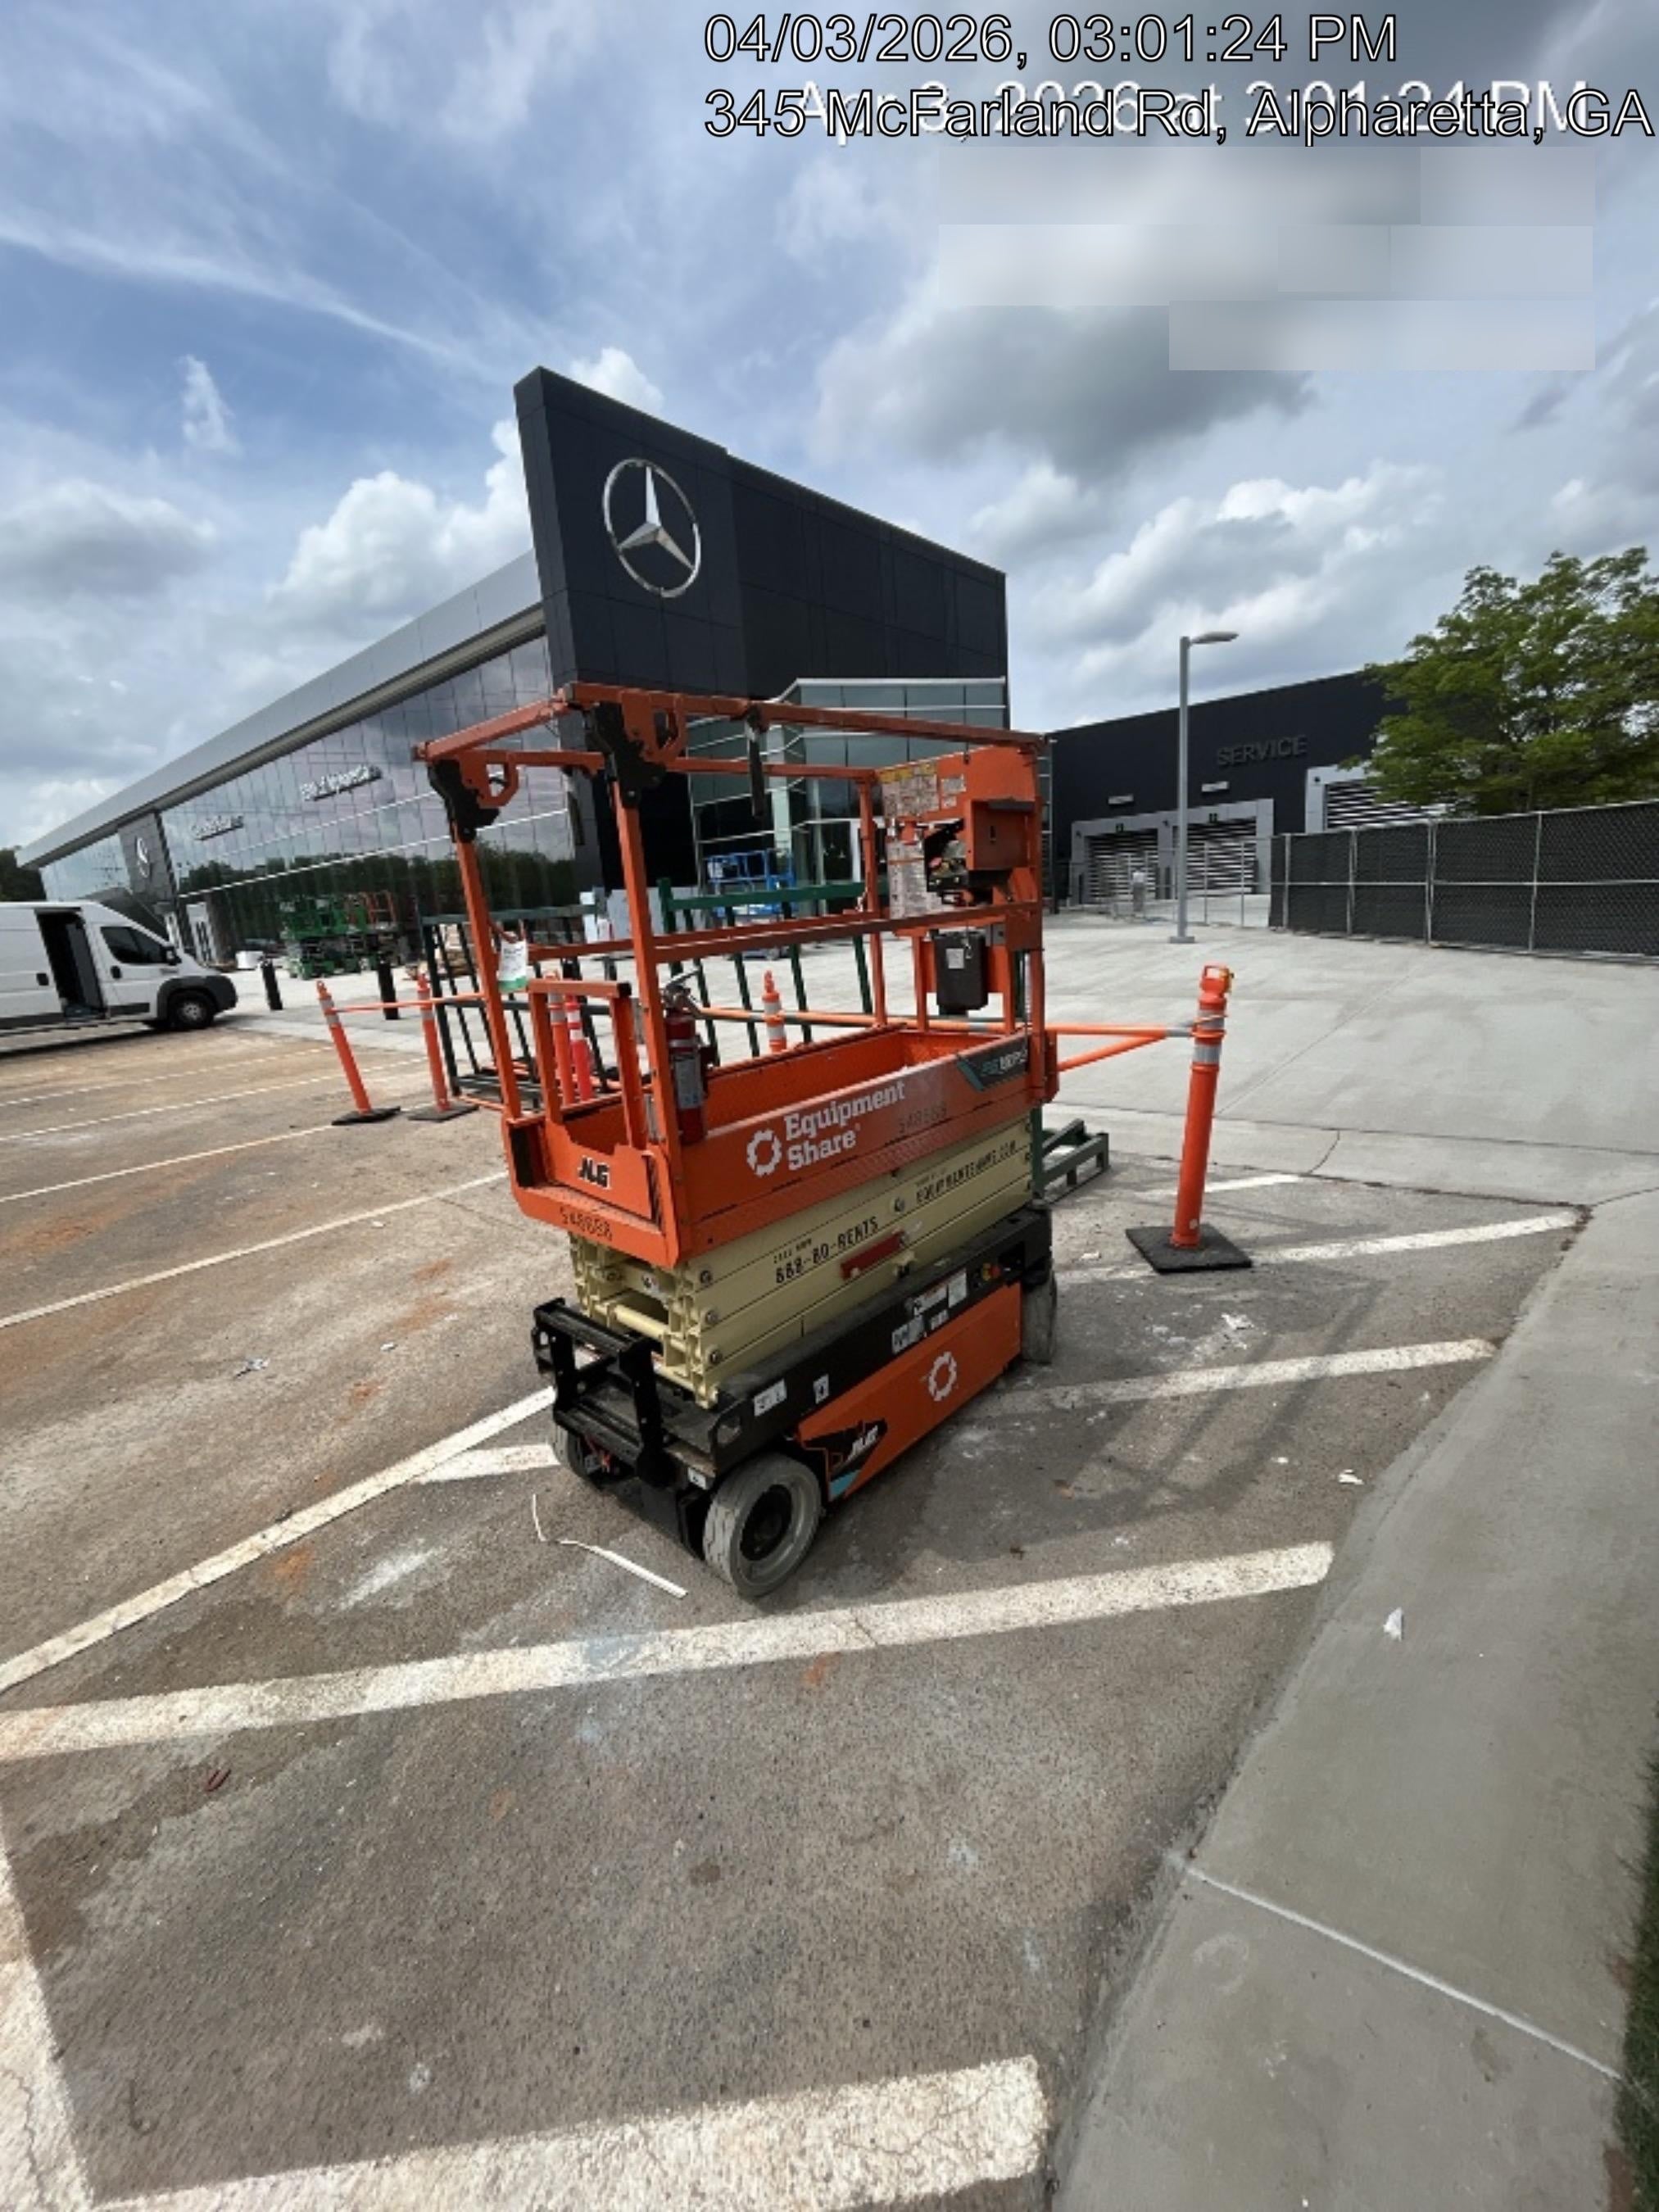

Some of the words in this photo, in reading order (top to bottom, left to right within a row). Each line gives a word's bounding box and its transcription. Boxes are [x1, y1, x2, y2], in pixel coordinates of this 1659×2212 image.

[1217, 734, 1308, 766] SERVICE
[784, 1081, 905, 1140] Equipment
[787, 1130, 857, 1171] Share
[577, 1154, 612, 1190] JLG
